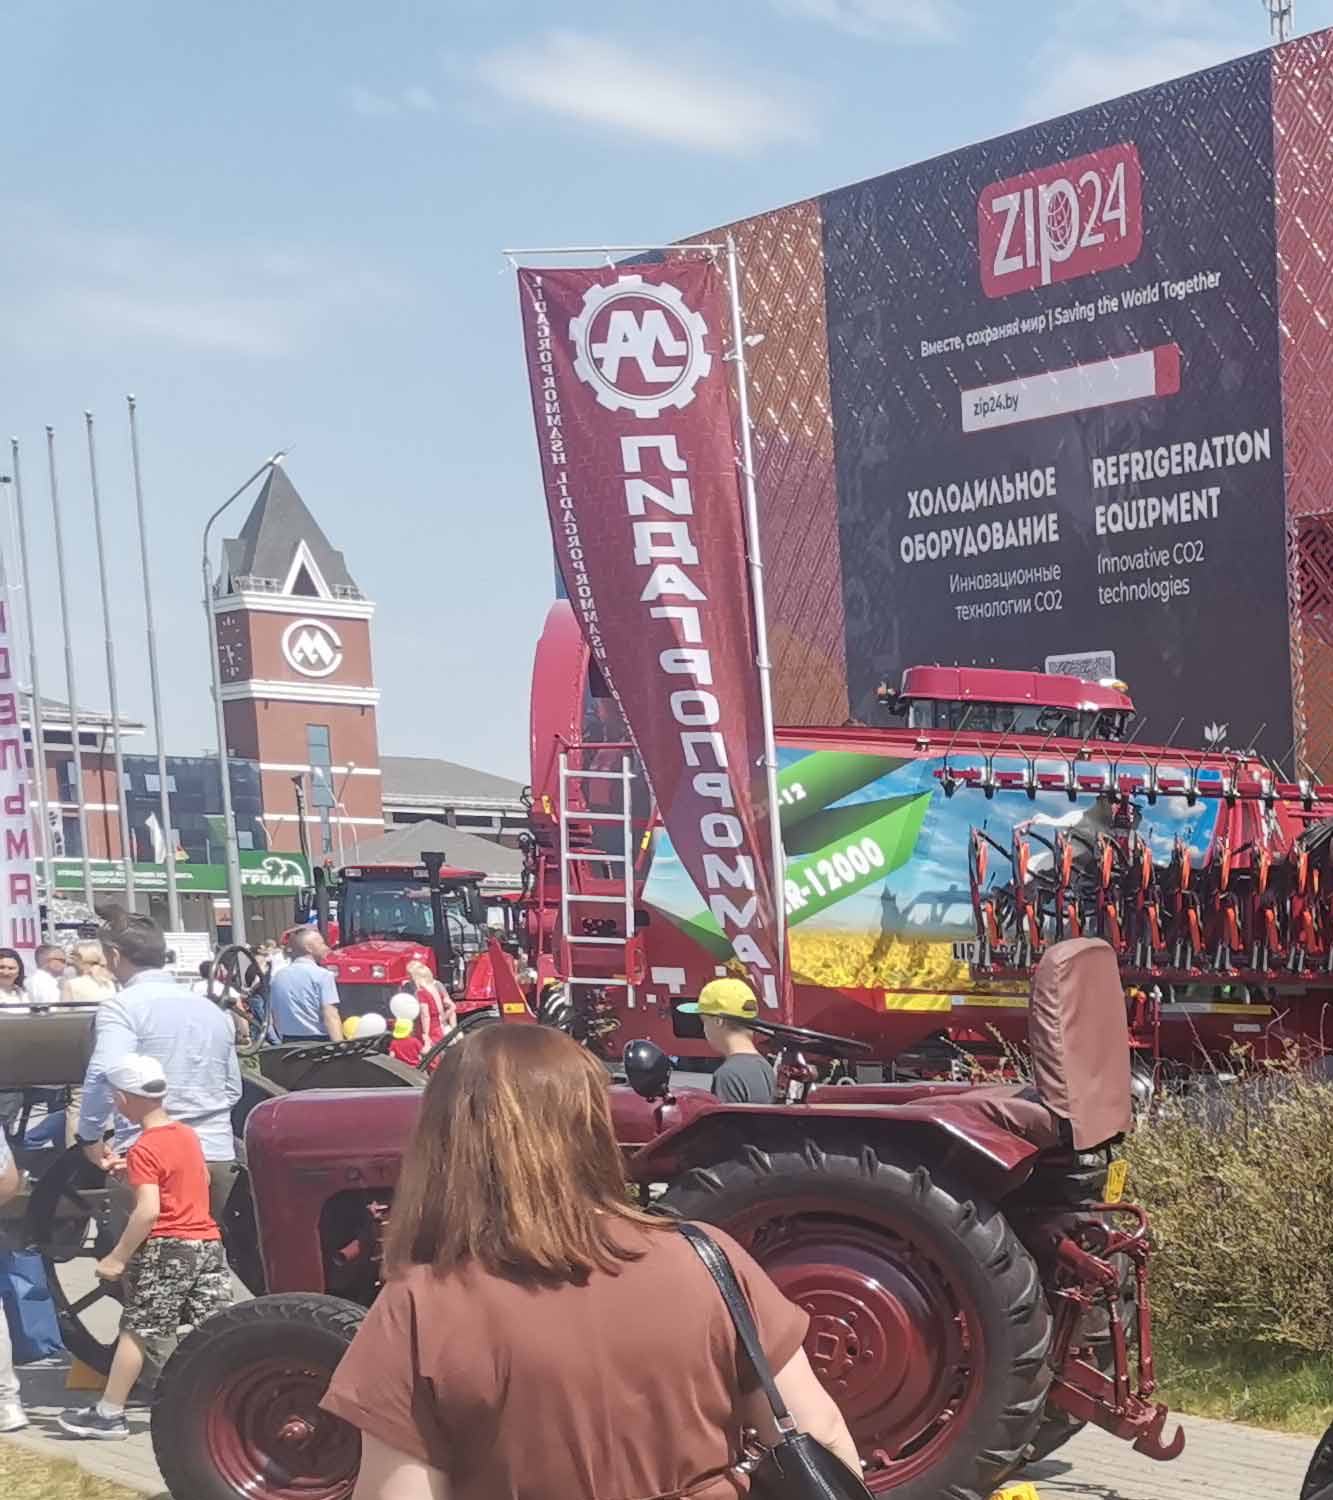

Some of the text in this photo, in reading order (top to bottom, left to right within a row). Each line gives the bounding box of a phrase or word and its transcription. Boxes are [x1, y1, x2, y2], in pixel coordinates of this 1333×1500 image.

[920, 335, 966, 358] Вместе,
[1055, 302, 1095, 327] Saving
[1097, 295, 1119, 314] the
[1121, 282, 1160, 307] World
[1161, 271, 1223, 302] Together
[972, 391, 1020, 418] zip24.by
[1091, 427, 1272, 489] REFRIGERATION
[906, 466, 1057, 520] ХОЛОДИЛЬНОЕ
[1094, 486, 1222, 536] EQUIPMENT
[899, 511, 1060, 564] ОБОРУДОВАНИЕ
[1097, 540, 1206, 576] Innovative CO2
[949, 560, 1063, 595] Инновационные
[1097, 575, 1191, 606] technologies
[954, 596, 1033, 622] технологии
